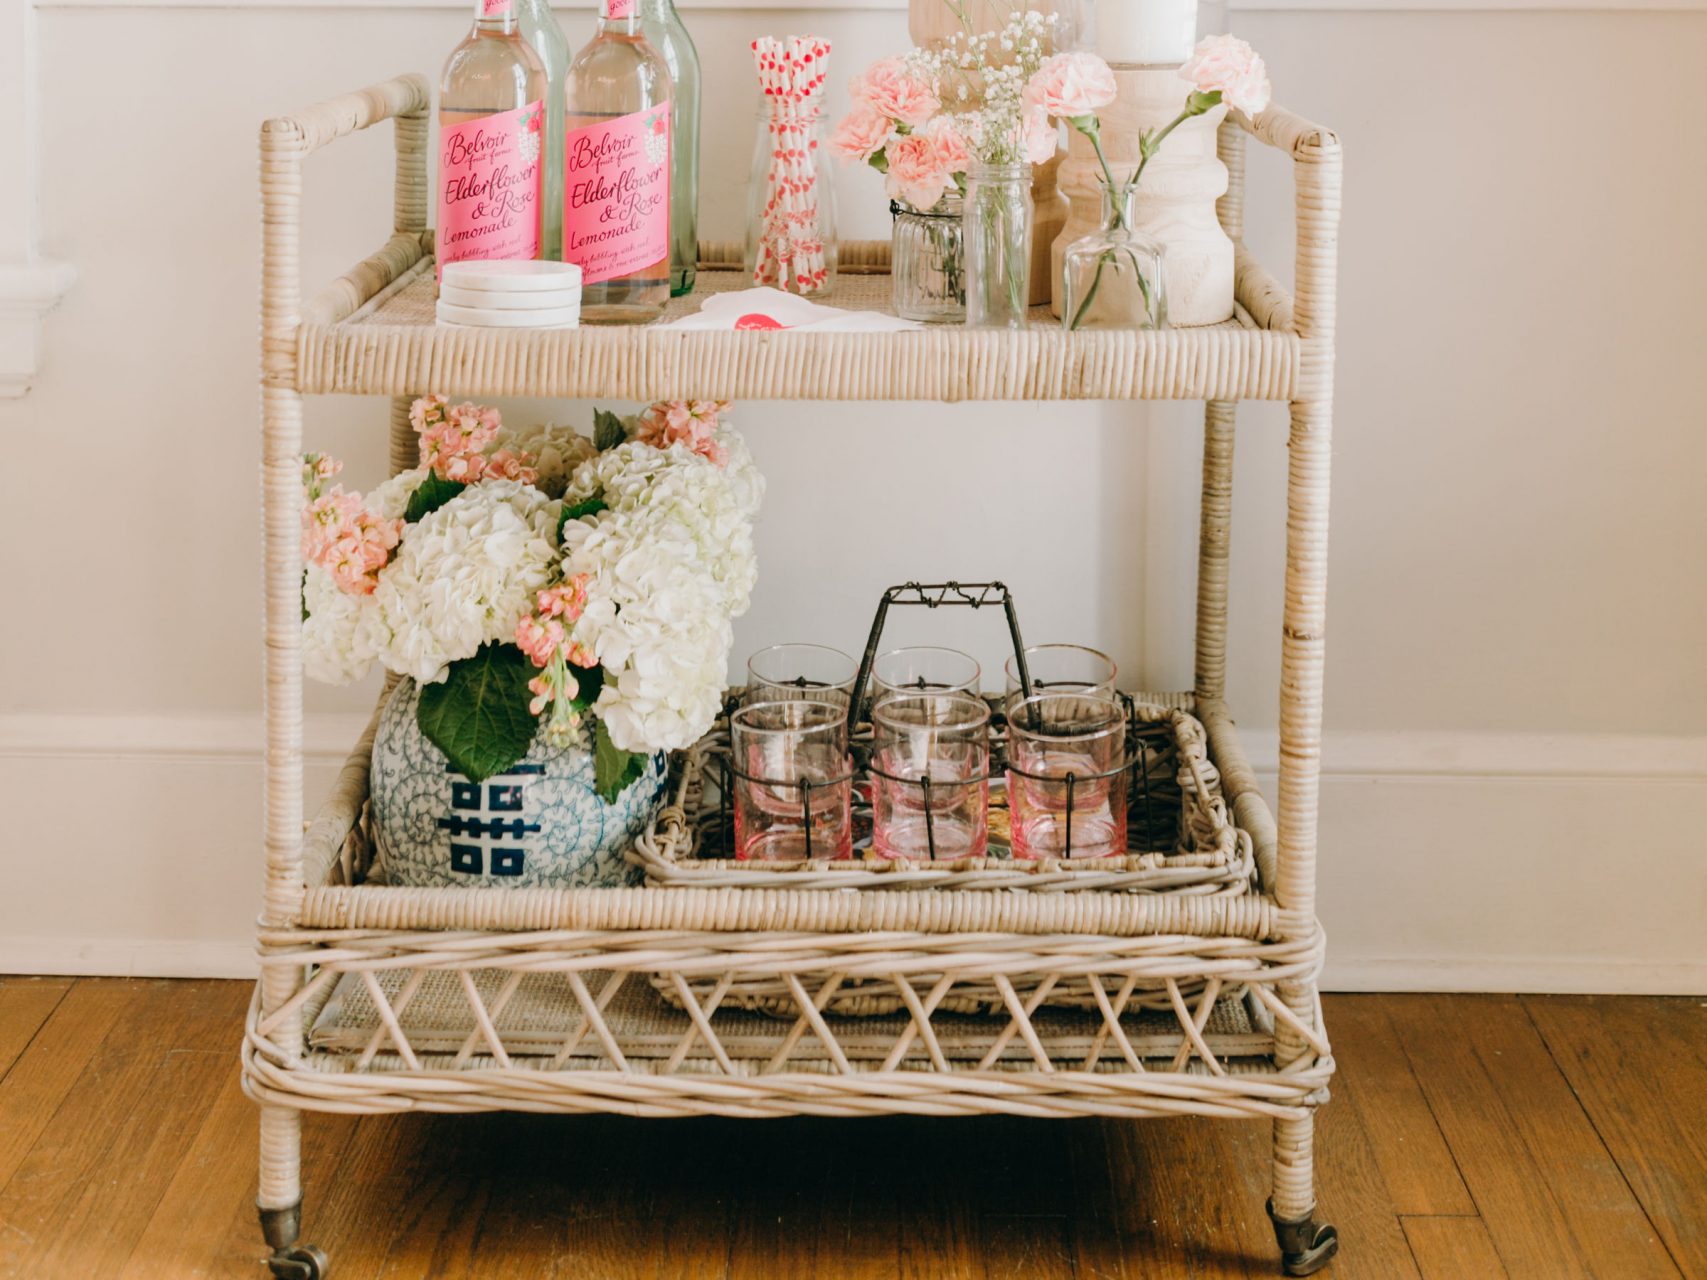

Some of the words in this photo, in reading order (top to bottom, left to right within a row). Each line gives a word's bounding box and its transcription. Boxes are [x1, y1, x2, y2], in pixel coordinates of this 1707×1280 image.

[443, 129, 511, 169] Belvoir
[569, 132, 637, 173] Belvoir
[444, 164, 536, 205] Elderflower
[571, 166, 662, 209] Elderflower
[471, 201, 489, 220] &
[491, 190, 535, 218] Rose
[599, 204, 619, 223] &
[619, 192, 662, 221] Rose
[443, 210, 517, 246] Lemonade
[571, 211, 645, 250] Lemonade
